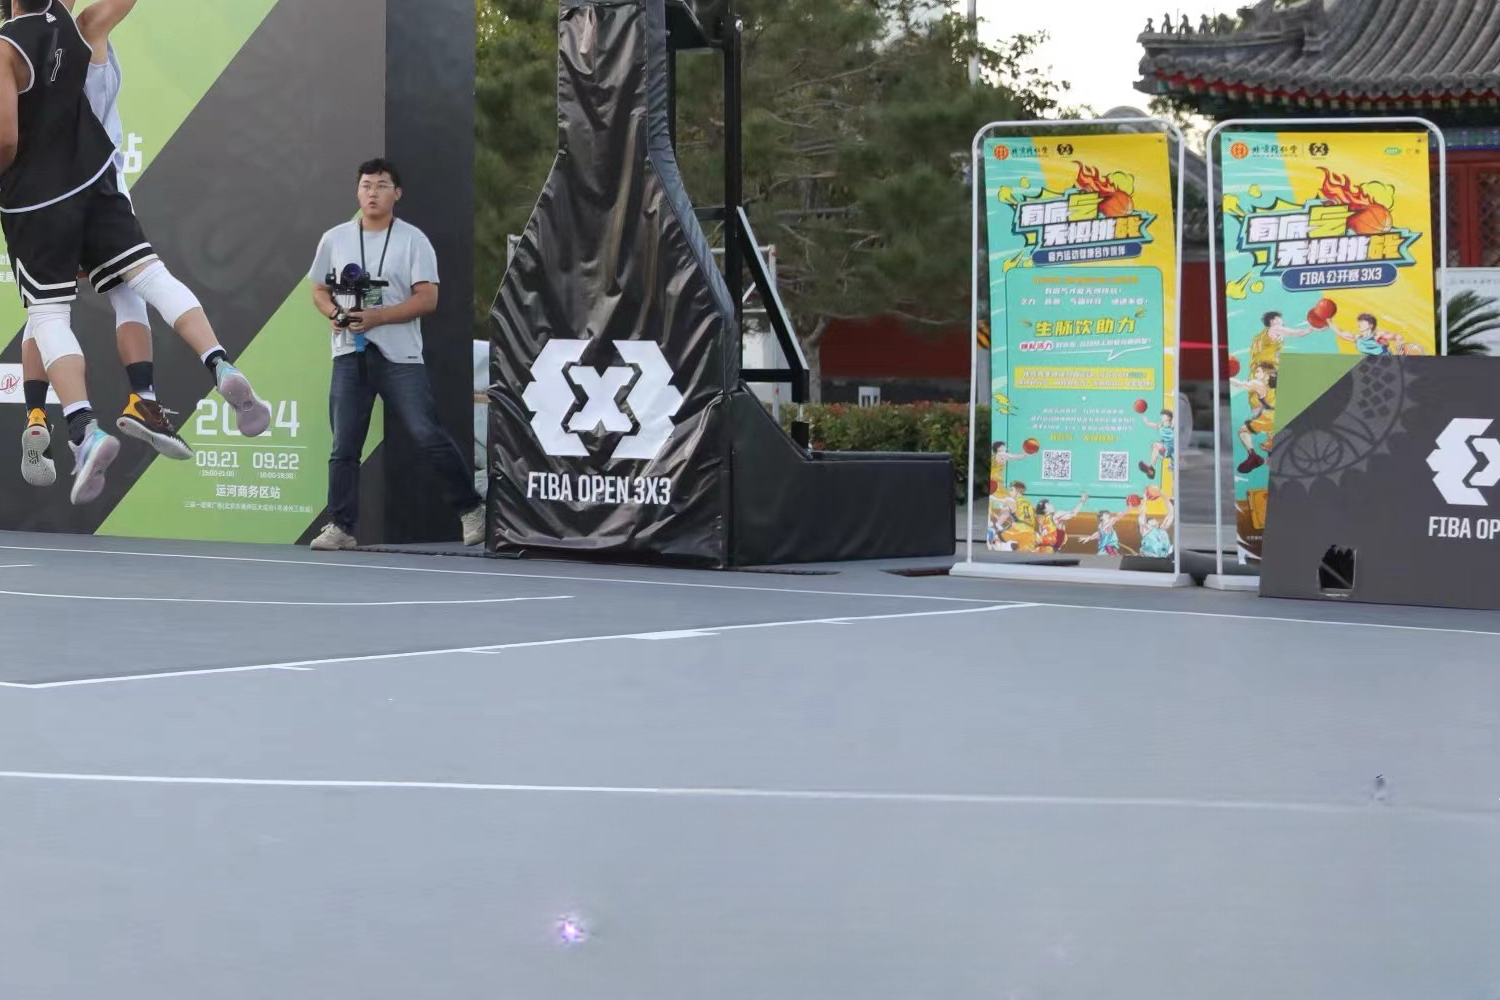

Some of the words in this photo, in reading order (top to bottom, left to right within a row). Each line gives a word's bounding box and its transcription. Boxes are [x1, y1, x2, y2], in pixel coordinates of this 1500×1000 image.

[1299, 270, 1325, 286] FIBA
[1360, 267, 1383, 281] 3X3
[1035, 316, 1136, 337] 生脉饮助力
[195, 449, 240, 469] 09.21
[252, 452, 300, 471] 09.22
[215, 484, 281, 499] 运河商务区站
[526, 471, 573, 502] FIBA
[577, 474, 629, 504] OPEN
[633, 475, 672, 505] 3X3
[1428, 515, 1472, 539] FIBA
